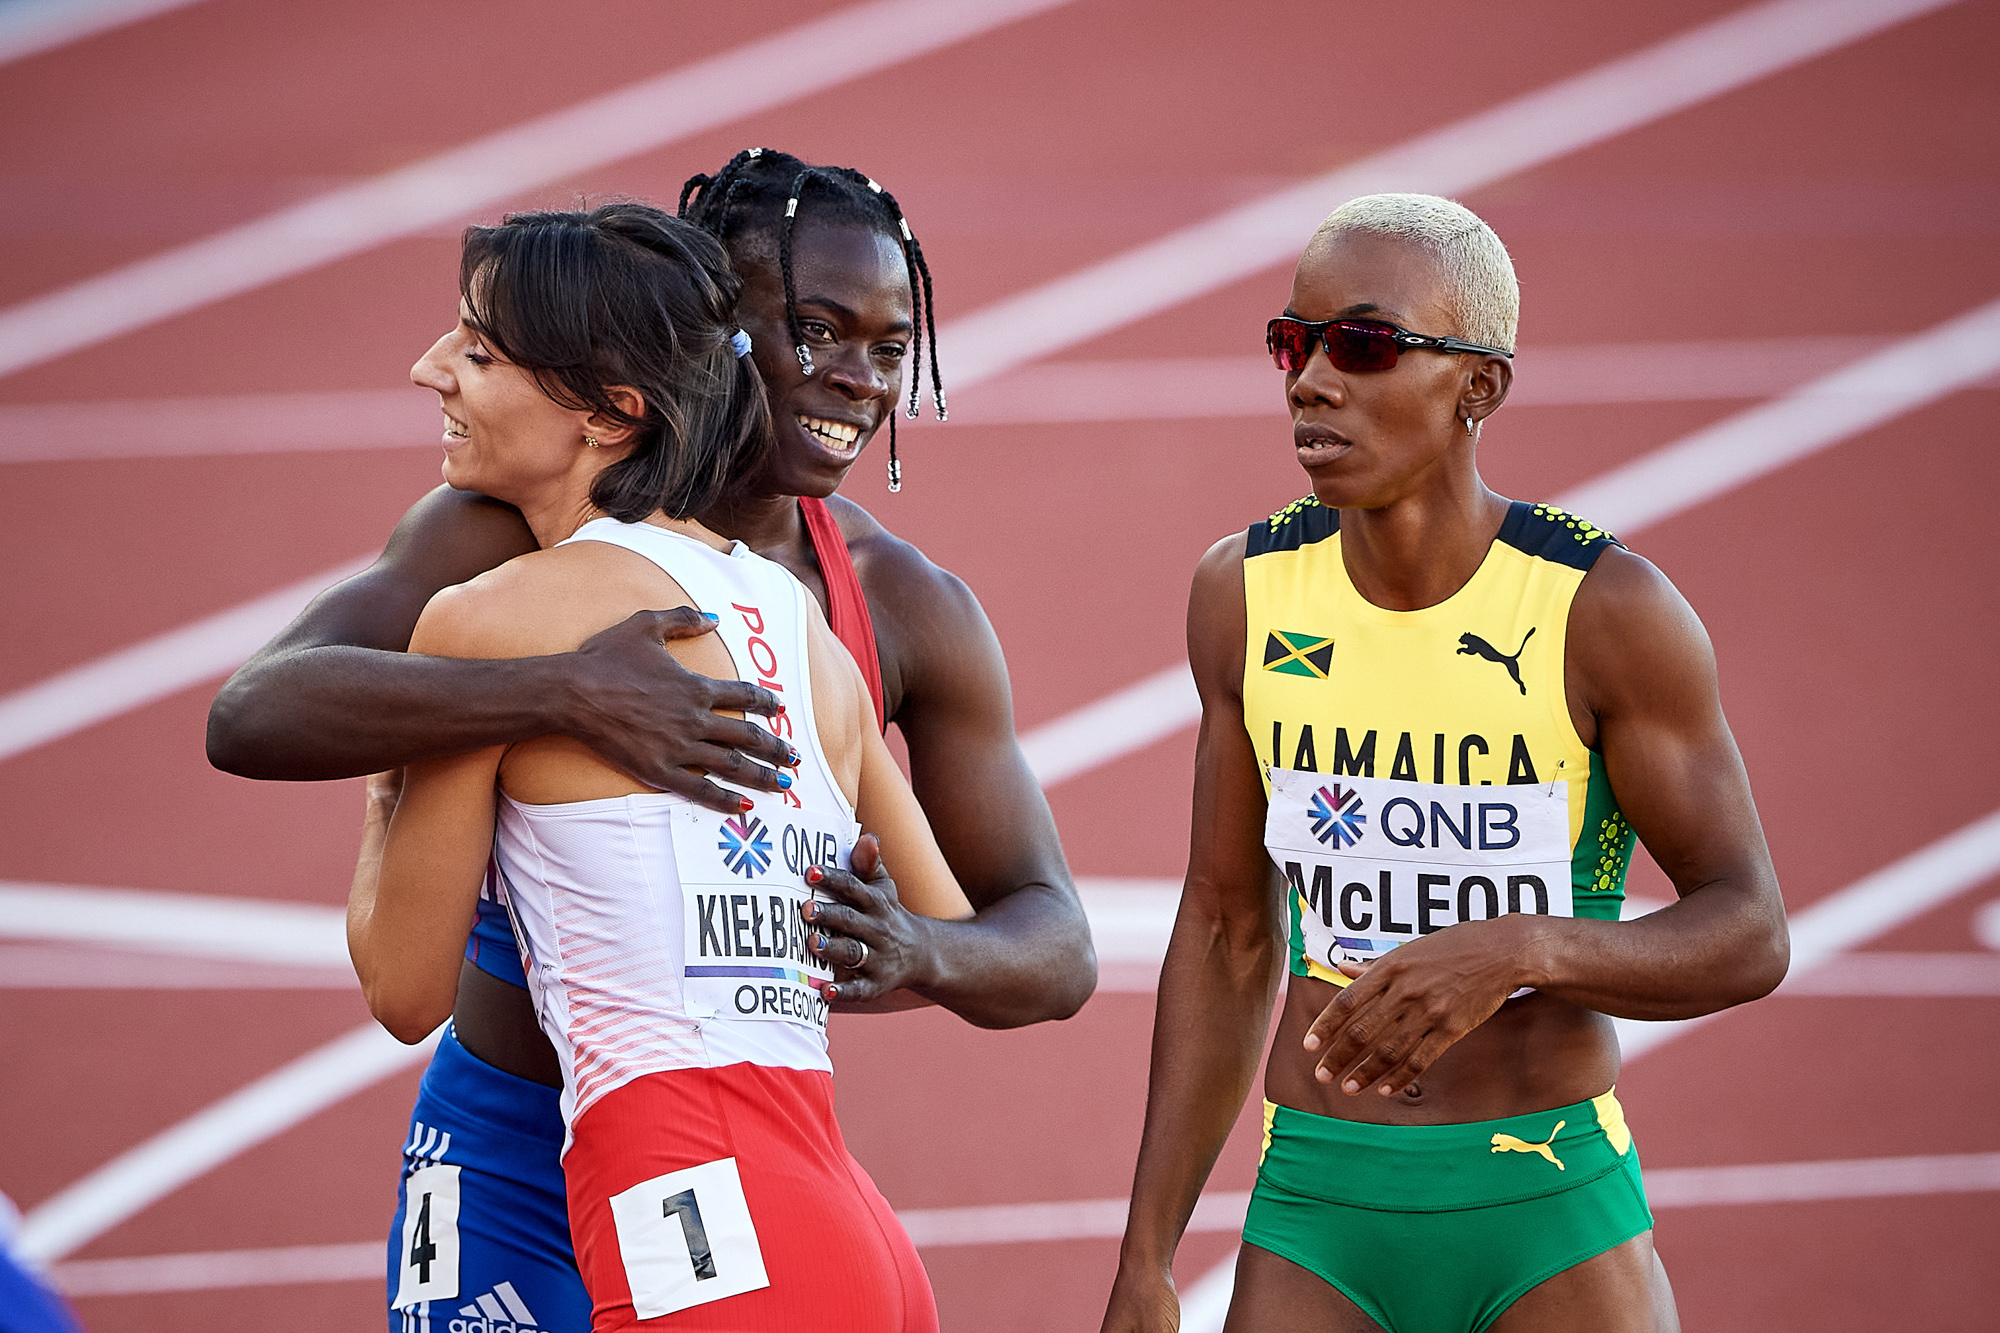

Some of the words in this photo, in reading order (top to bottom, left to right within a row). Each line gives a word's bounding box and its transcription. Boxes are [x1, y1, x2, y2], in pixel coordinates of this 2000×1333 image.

[731, 602, 801, 809] POLS
[1265, 721, 1540, 786] JAMAICA
[782, 823, 838, 876] QNB
[1381, 797, 1521, 850] QNB
[1284, 861, 1549, 936] McLEOD
[410, 1192, 437, 1284] 4
[662, 1188, 718, 1282] 1
[448, 1317, 551, 1333] adid
